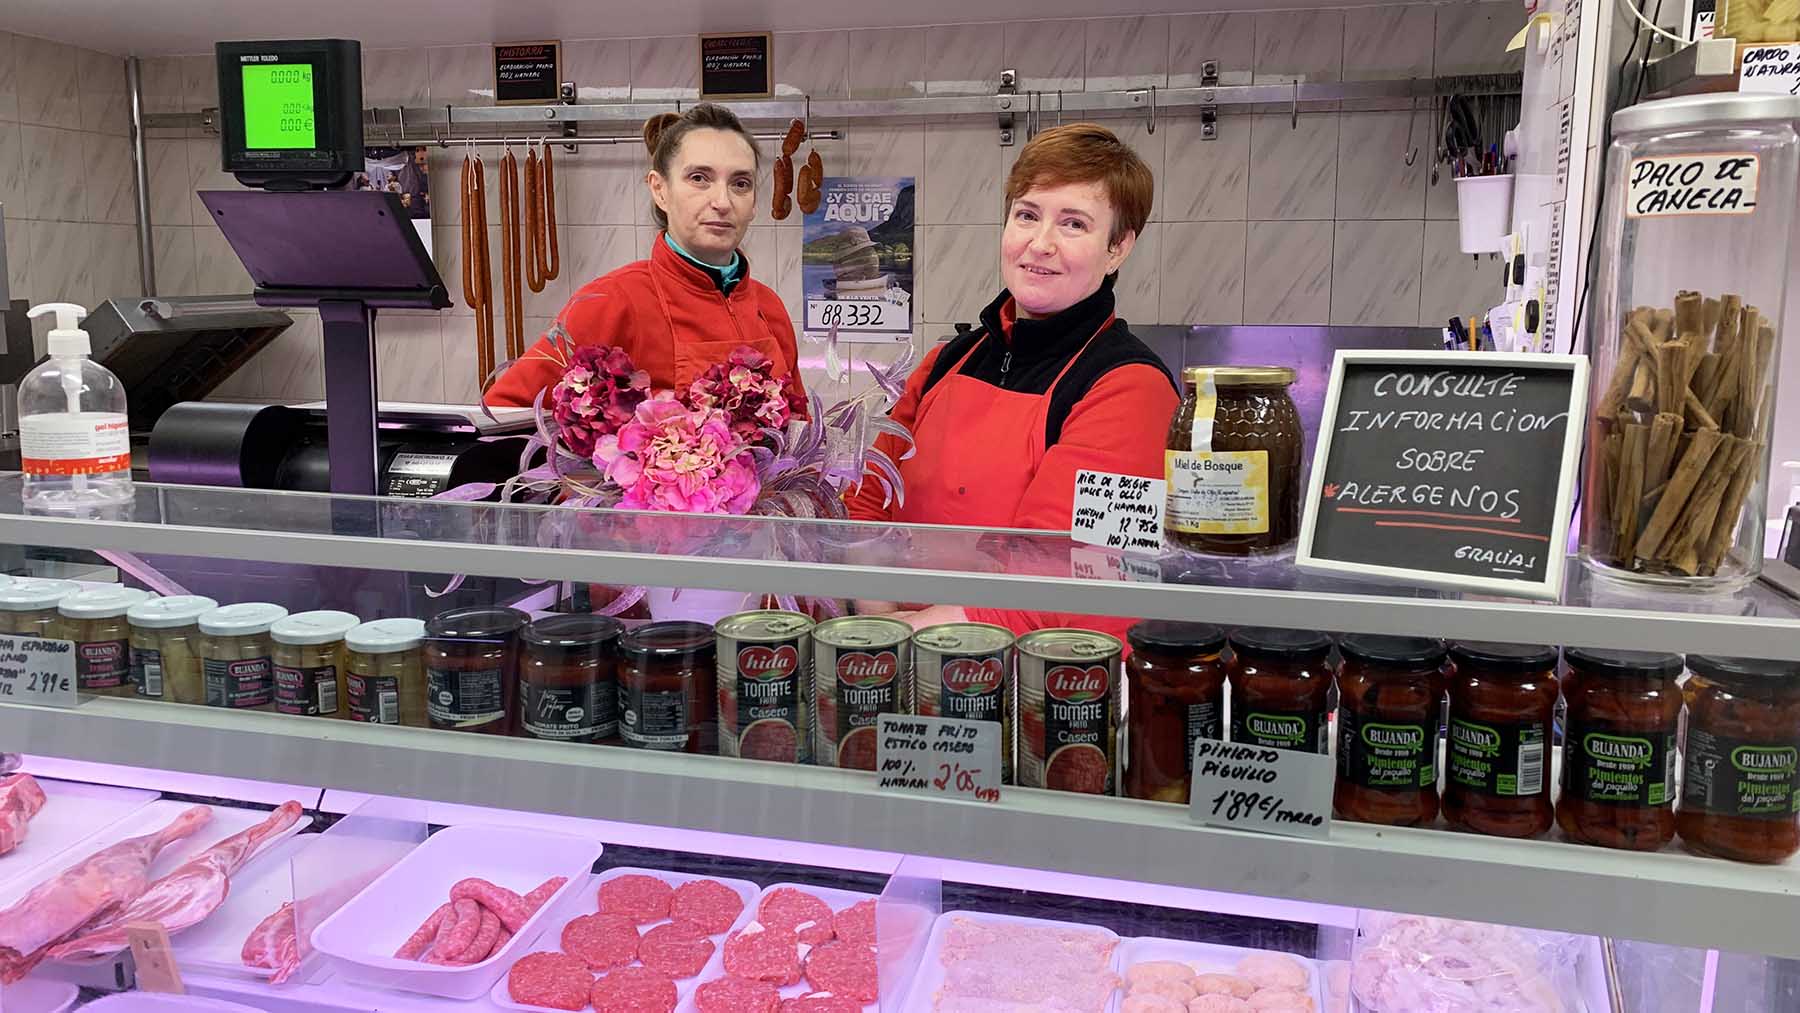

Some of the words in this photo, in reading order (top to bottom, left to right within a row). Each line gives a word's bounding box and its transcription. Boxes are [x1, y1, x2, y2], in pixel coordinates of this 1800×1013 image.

[1744, 48, 1790, 64] CARDO
[1631, 160, 1704, 190] PALO
[1714, 158, 1755, 180] DE
[826, 193, 843, 204] ¿Y
[846, 193, 859, 204] SI
[861, 193, 892, 204] CAE
[824, 203, 894, 223] AQUÍ?
[821, 303, 885, 326] 88.332
[1374, 371, 1526, 398] CONSULTE
[1175, 458, 1190, 470] Miel
[1191, 460, 1202, 471] de
[1204, 460, 1244, 474] Bosque
[1396, 447, 1484, 473] SOBRE
[1337, 480, 1520, 519] ALERGENOS
[745, 653, 789, 670] hida
[845, 660, 890, 677] hida
[951, 667, 995, 684] hida
[1055, 675, 1101, 691] hida
[743, 680, 792, 698] TOMATE
[842, 687, 892, 704] TOMATE
[750, 706, 789, 719] Casero
[949, 695, 998, 712] TOMATE
[1052, 703, 1102, 721] TOMATE
[883, 721, 928, 737] TOMATE
[938, 724, 978, 739] FRITO
[1253, 719, 1299, 735] BUJANDA
[884, 735, 928, 750] ESTILO
[932, 741, 975, 754] CASERO
[1057, 731, 1099, 744] Casero
[1369, 729, 1419, 745] BUJANDA
[1199, 743, 1280, 763] PIMIENTO
[1592, 740, 1644, 758] BUJANDA
[1202, 761, 1277, 784] PIQUILLO
[1588, 767, 1644, 785] Pimientos
